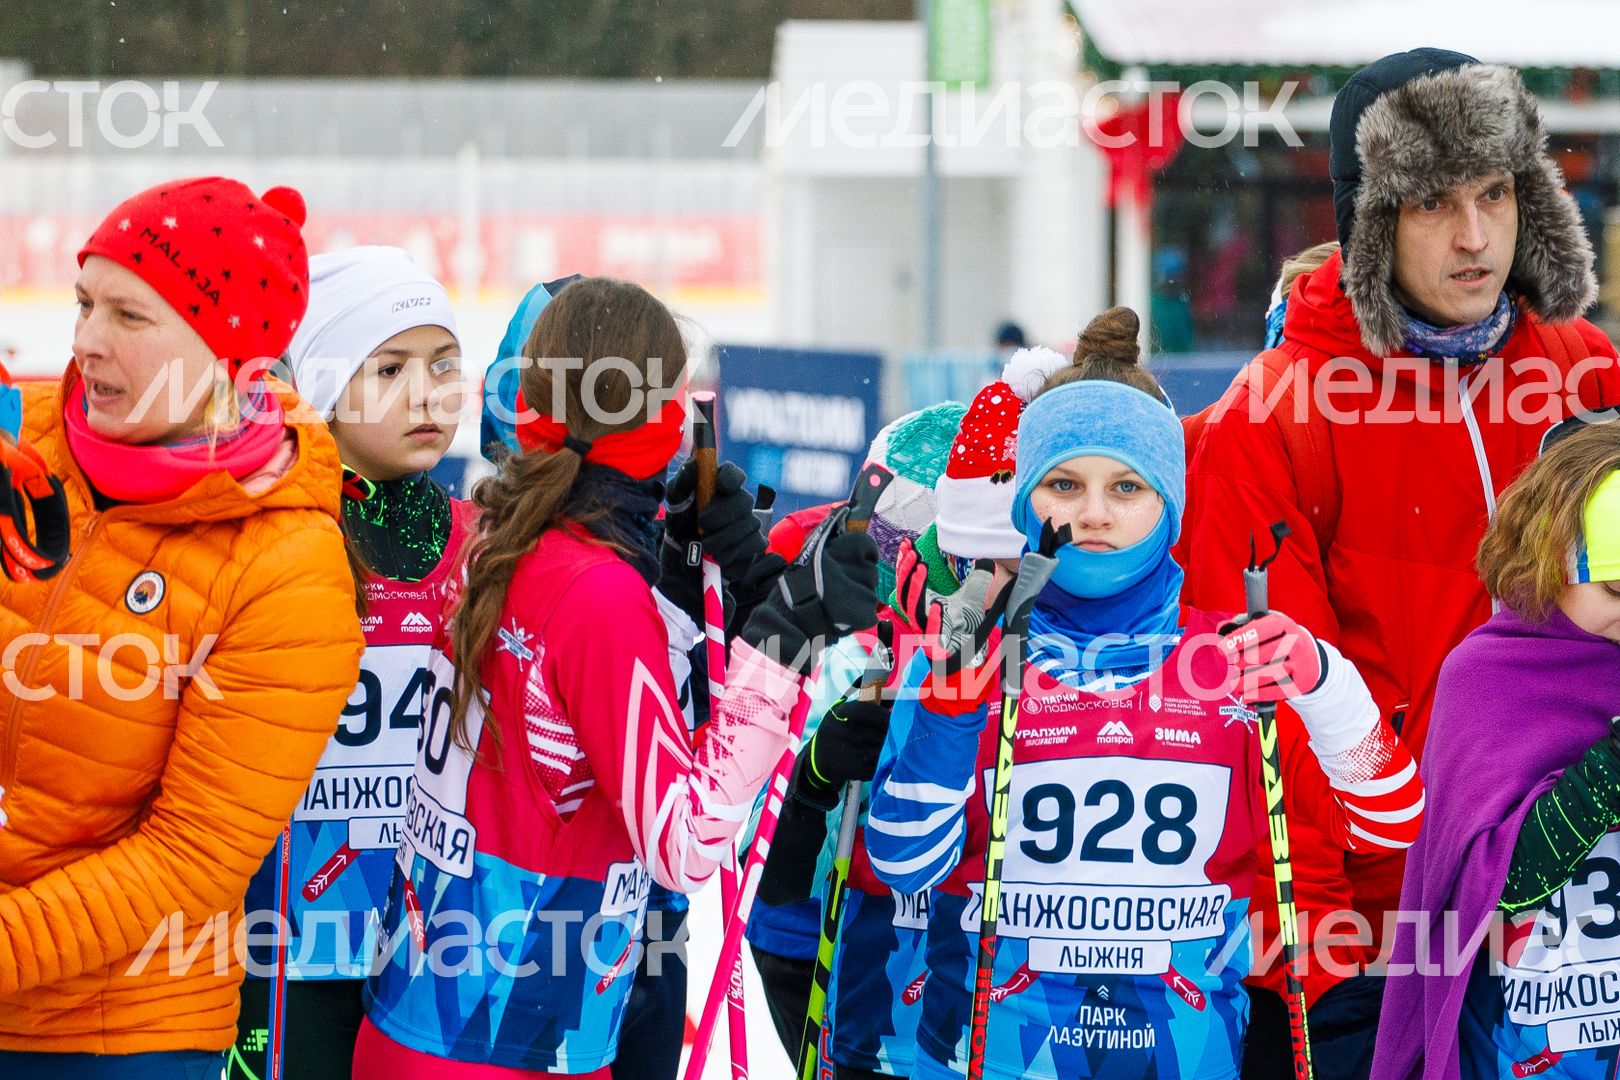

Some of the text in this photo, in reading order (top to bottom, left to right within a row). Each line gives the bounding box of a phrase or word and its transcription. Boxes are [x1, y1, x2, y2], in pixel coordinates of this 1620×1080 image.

[1015, 726, 1078, 740] УРАЛХИМ
[1154, 727, 1202, 744] ЗИМА
[1020, 779, 1198, 866] 928
[1257, 716, 1301, 947] SABLE
[1058, 945, 1145, 969] ЛЫЖНЯ
[1079, 1004, 1127, 1026] ПАРК
[1048, 1023, 1156, 1050] ЛАЗУТИНОЙ
